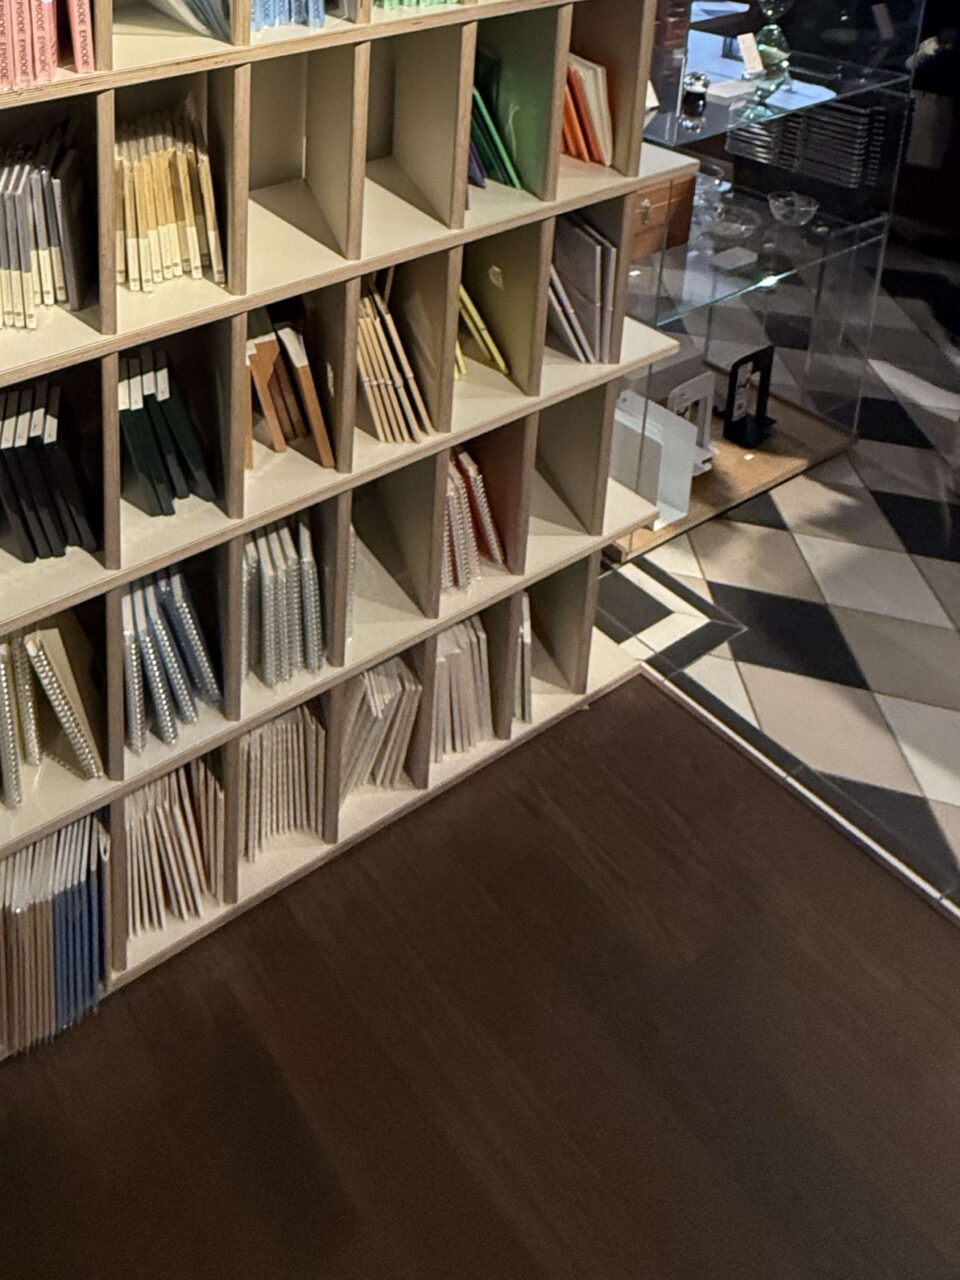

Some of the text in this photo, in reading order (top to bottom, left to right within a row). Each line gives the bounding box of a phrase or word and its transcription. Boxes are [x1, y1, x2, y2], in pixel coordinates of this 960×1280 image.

[0, 43, 8, 80] EPISODE
[19, 39, 28, 77] EPISODE
[79, 30, 89, 65] EPISODE
